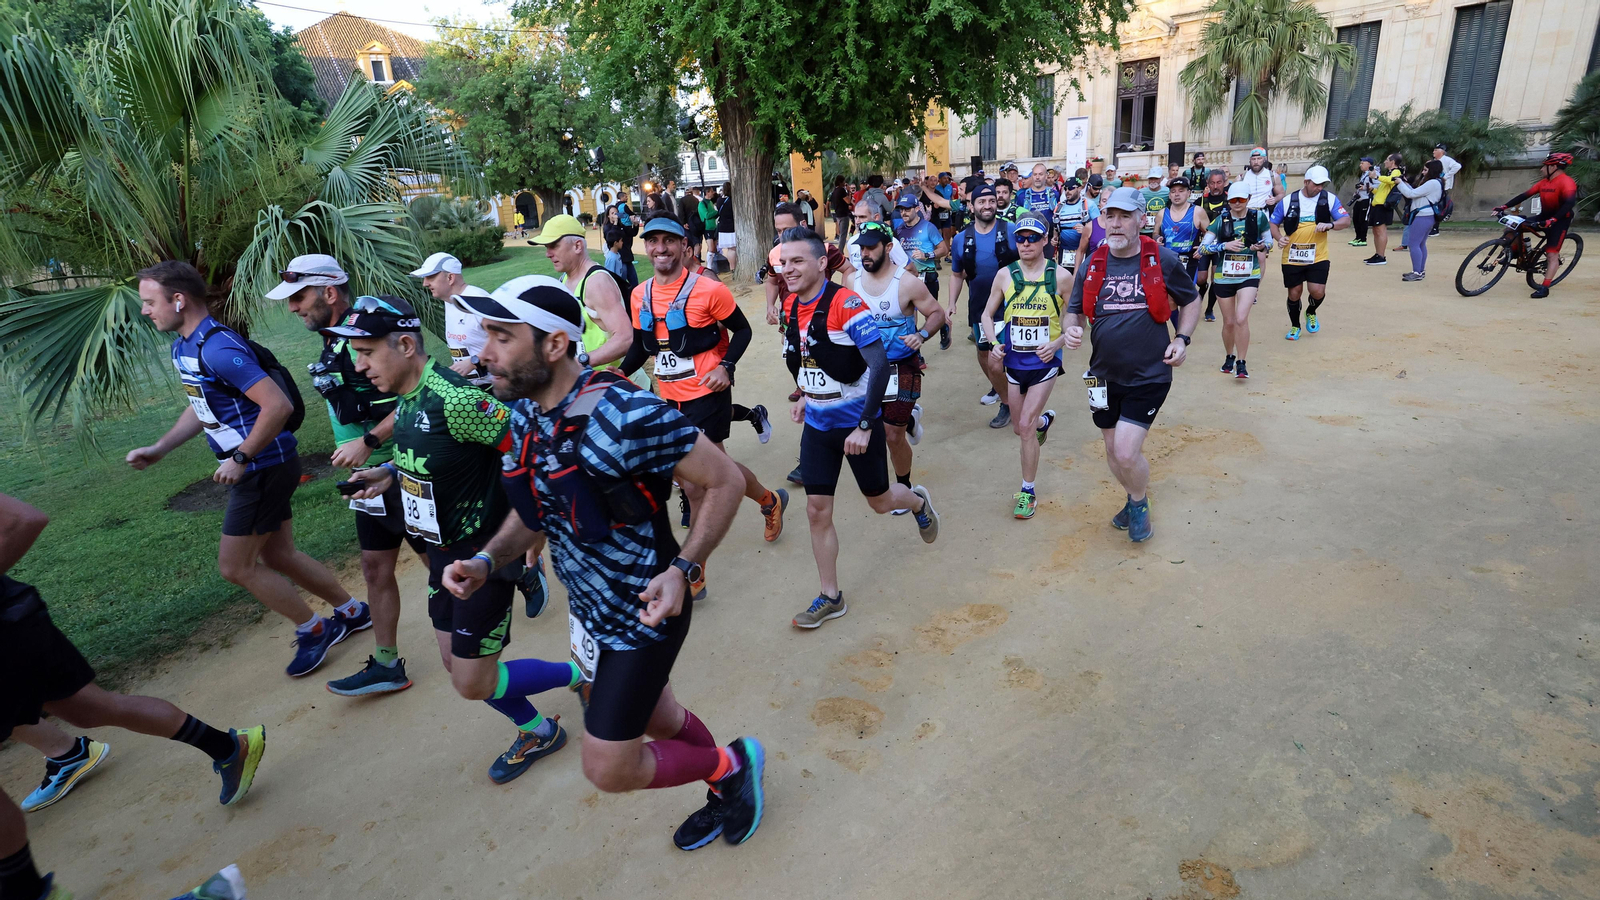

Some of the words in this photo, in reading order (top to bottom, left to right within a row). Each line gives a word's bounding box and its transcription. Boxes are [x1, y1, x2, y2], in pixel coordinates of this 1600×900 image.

[1295, 250, 1309, 258] 106
[1230, 262, 1246, 271] 164
[1012, 303, 1047, 311] STRIDERS
[1018, 328, 1039, 341] 161
[660, 353, 677, 369] 46
[803, 370, 827, 388] 173
[406, 496, 421, 520] 98
[581, 633, 594, 661] 49
